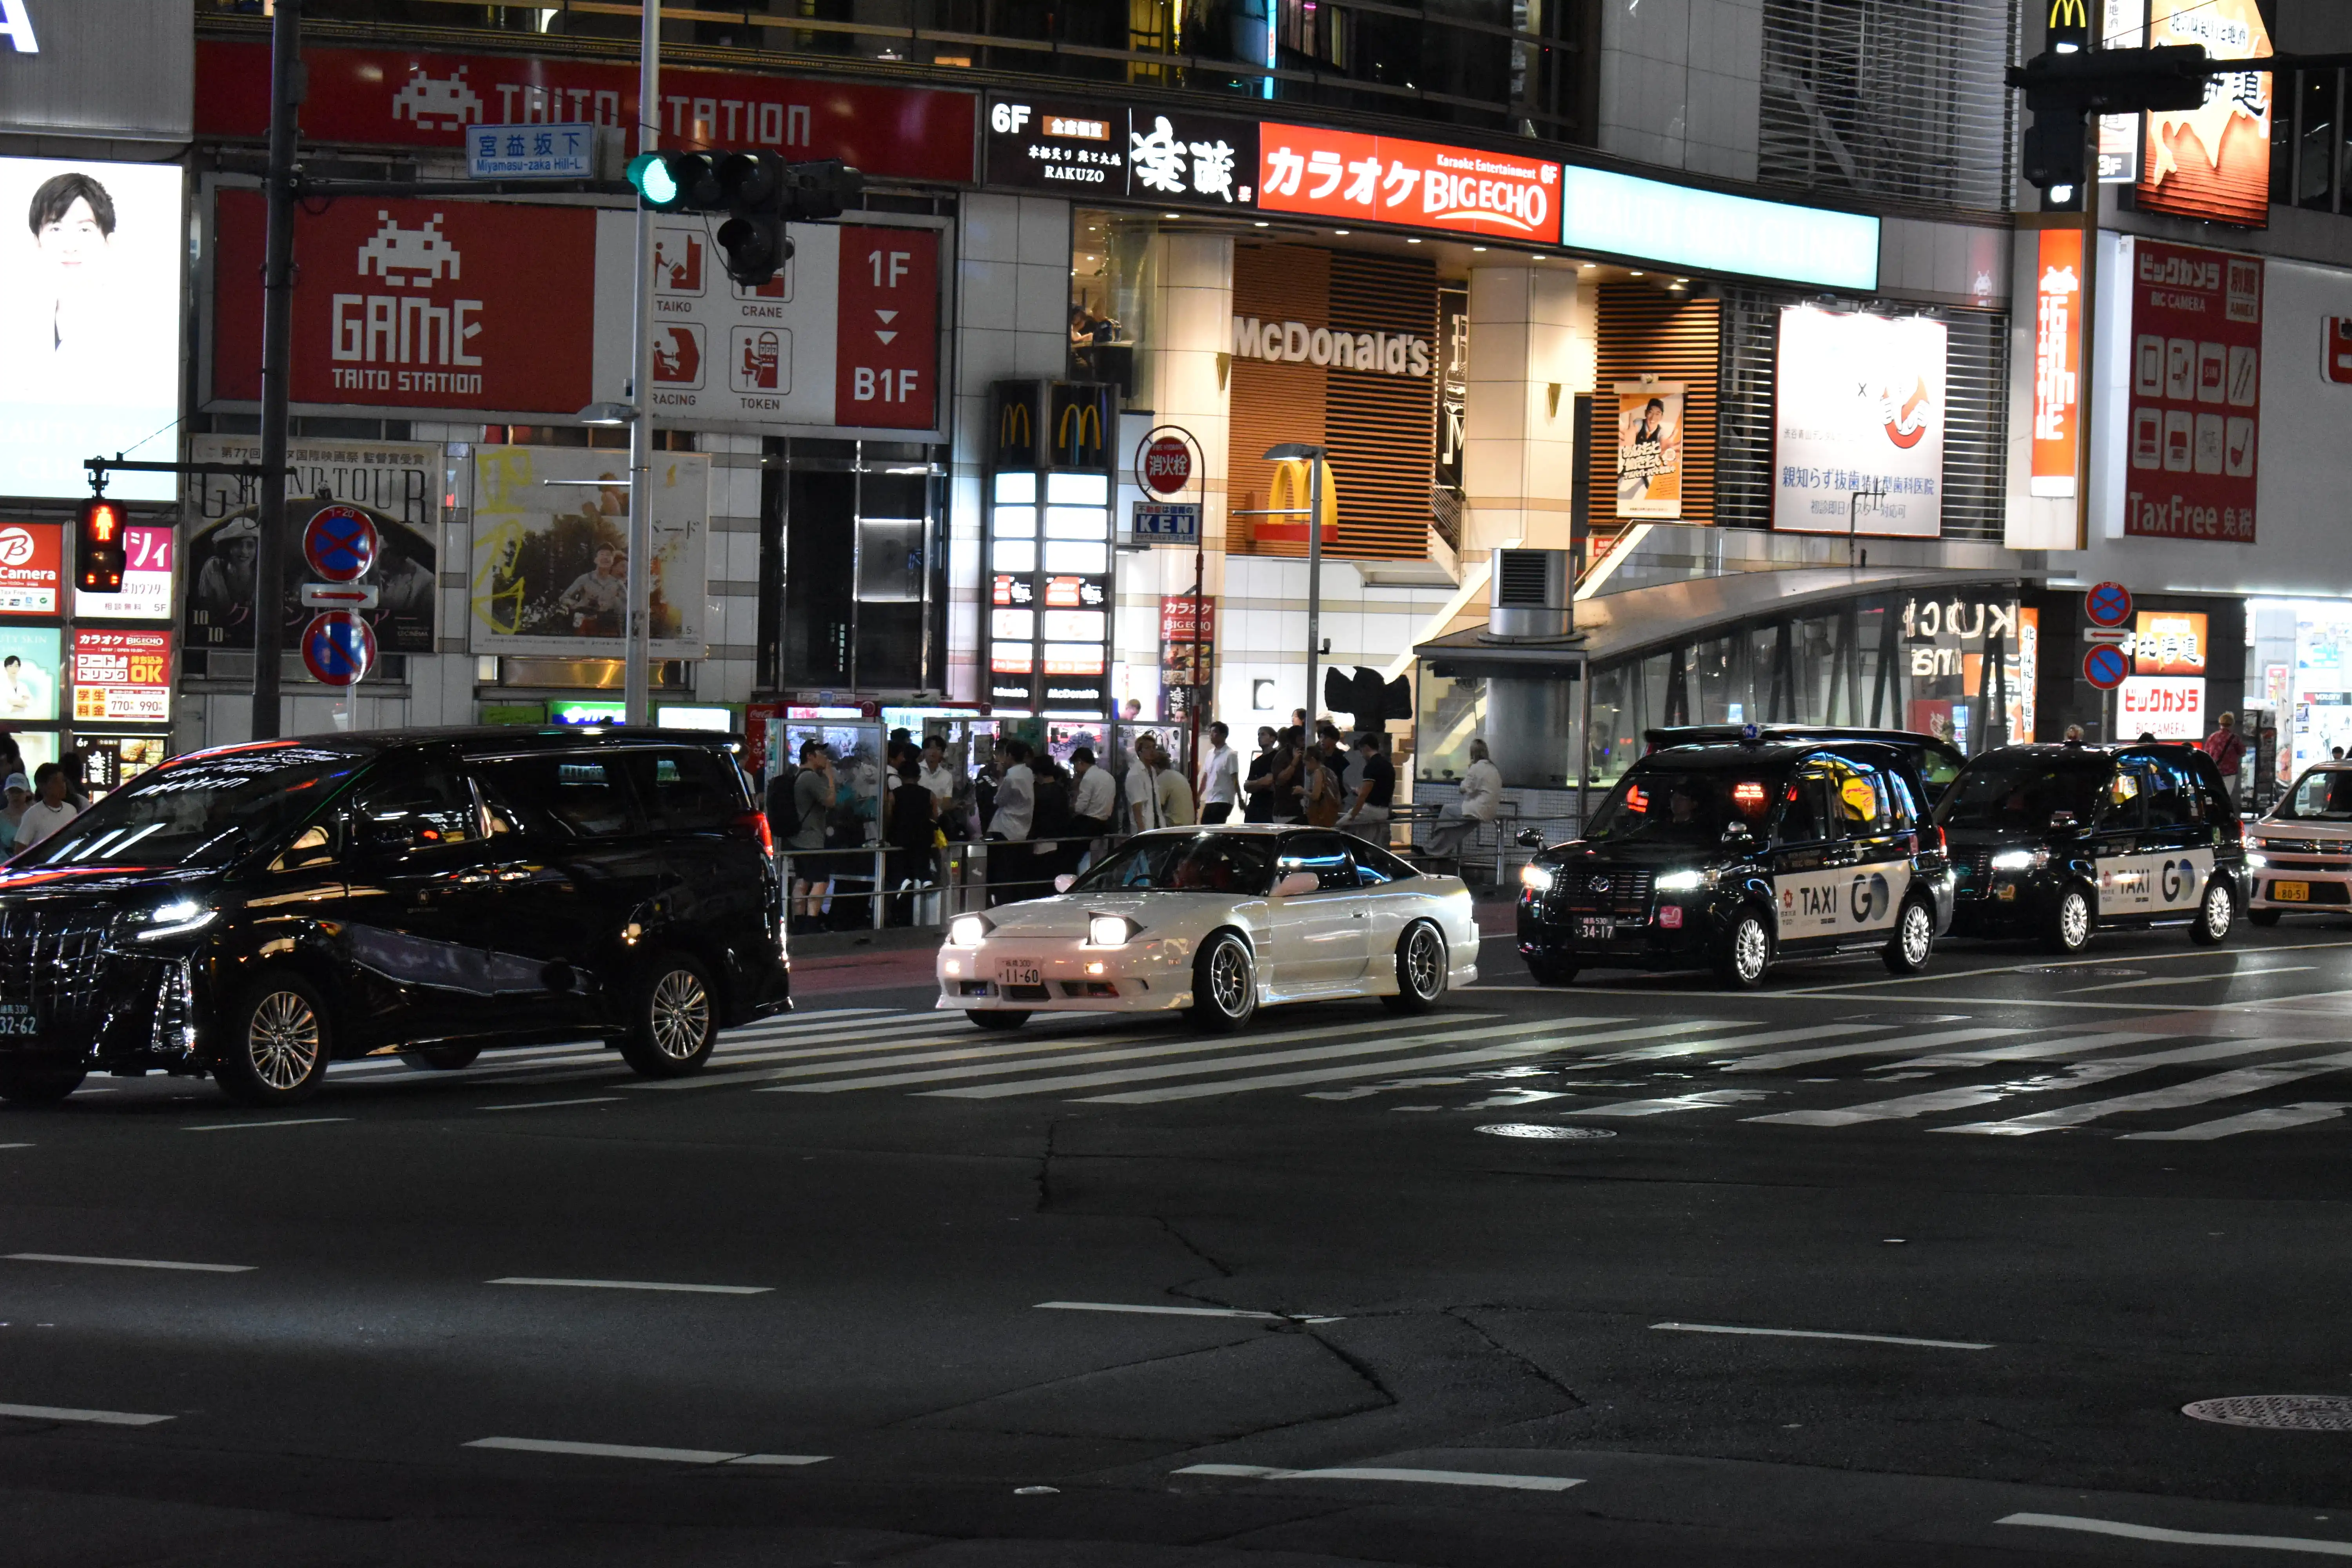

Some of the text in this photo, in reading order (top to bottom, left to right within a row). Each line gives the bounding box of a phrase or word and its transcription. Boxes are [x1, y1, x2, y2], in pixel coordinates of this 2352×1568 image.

[496, 83, 810, 147] TAITO TATION
[992, 103, 1031, 133] 6F
[479, 132, 581, 157] 宮益坂下
[477, 159, 551, 172] Miyamasu-zaka
[1044, 165, 1105, 183] RAKUZO
[1437, 154, 1536, 179] Karaoke Entertainment
[2098, 155, 2122, 176] 3F
[1264, 147, 1420, 207] カラオケ
[1424, 170, 1547, 226] BIG ECHO
[869, 250, 911, 288] 1F
[2140, 253, 2220, 290] ビックカメラ
[656, 300, 692, 313] TAIKO
[2151, 290, 2206, 313] BIC CAMERA
[741, 306, 783, 318] CRANE
[332, 293, 483, 366] GAME
[1232, 316, 1430, 377] McDonald's
[332, 368, 482, 394] TAITO STATION
[854, 367, 919, 403] B1F
[652, 393, 696, 406] RACING
[740, 397, 780, 410] TOKEN
[221, 447, 359, 463] 第77回ヌ国際映画祭
[1149, 454, 1188, 476] 消火栓
[1782, 465, 1935, 495] 親知らず抜歯特化型歯科医院
[201, 466, 429, 524] GRND TOUR
[2129, 492, 2218, 532] TaxFree
[1140, 515, 1190, 534] KEN
[2223, 508, 2252, 536] 免税
[192, 610, 209, 624] 10
[1164, 620, 1184, 630] BIG
[79, 634, 124, 645] カラオケ
[142, 637, 163, 645] ECHO
[208, 627, 223, 642] 10
[80, 655, 113, 667] フード
[80, 669, 126, 680] ドリンク
[131, 665, 163, 683] OK
[78, 690, 105, 701] 学生
[1048, 689, 1099, 699] McDonald's
[2125, 688, 2199, 713] ビックカメラ
[78, 705, 105, 716] 料金
[111, 701, 130, 711] 770
[140, 701, 158, 711] 990
[2152, 722, 2186, 735] CAMERA
[76, 737, 89, 747] 6F
[2118, 869, 2150, 895] TAXI
[1800, 885, 1837, 916] TAXI
[2282, 889, 2305, 899] 80-51
[1582, 925, 1613, 939] 34-17
[1006, 969, 1039, 983] 11-60
[15, 1005, 28, 1014] 330
